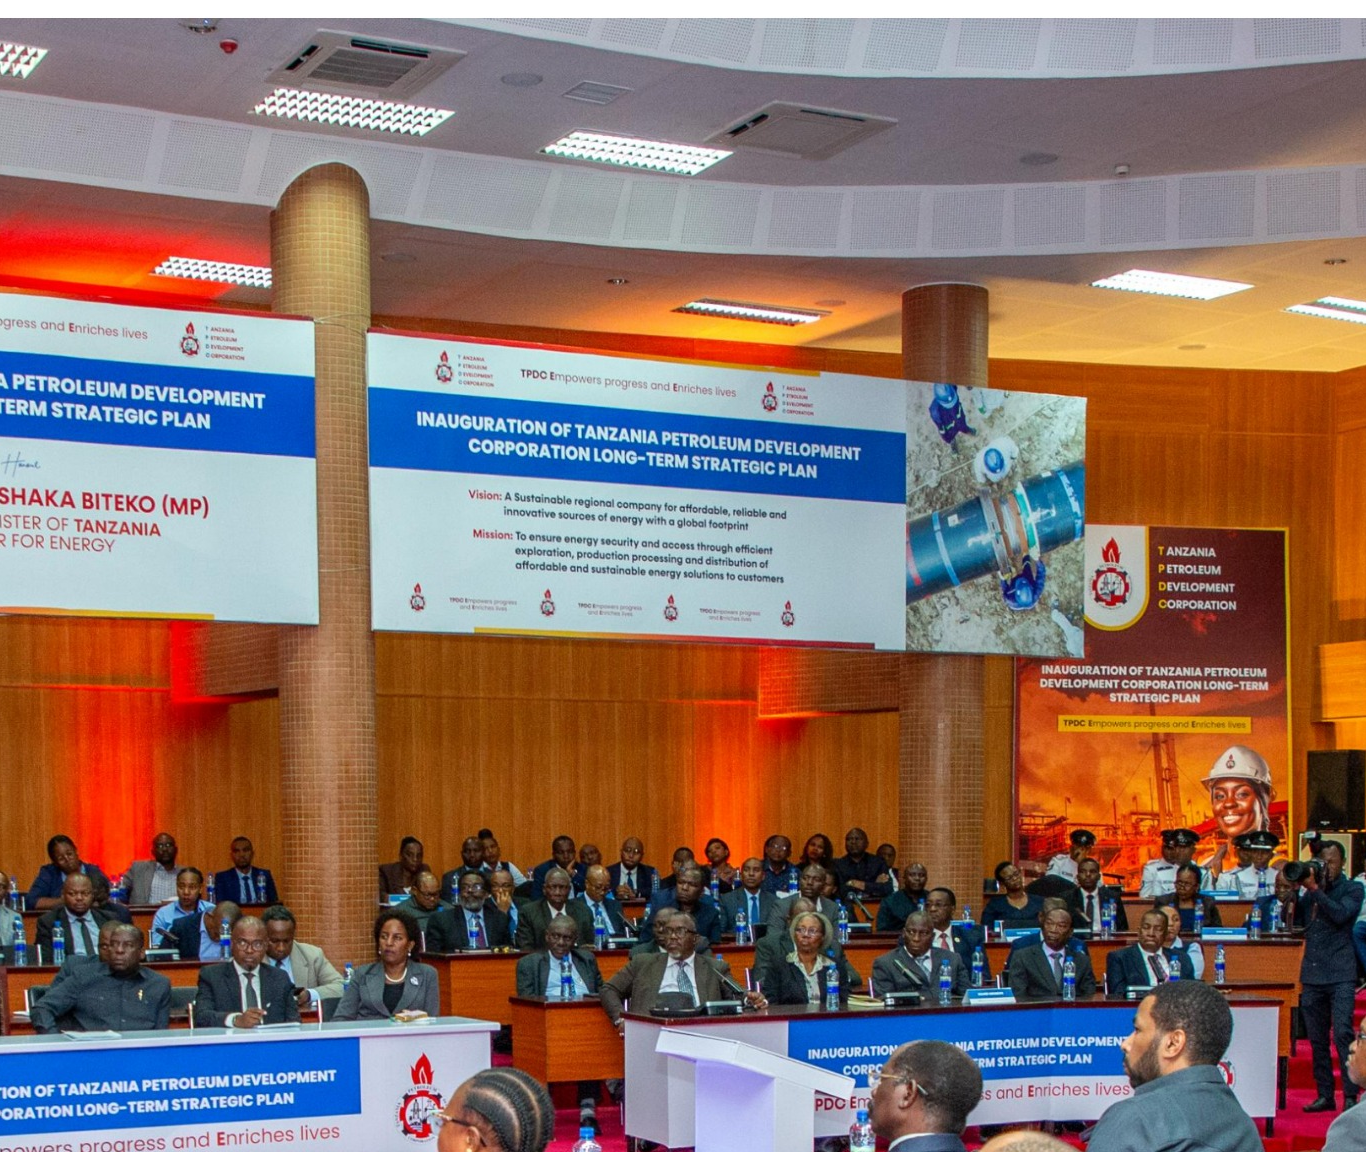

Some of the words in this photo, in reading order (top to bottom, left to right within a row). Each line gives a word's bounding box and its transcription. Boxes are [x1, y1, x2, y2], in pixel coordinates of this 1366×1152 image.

[40, 321, 64, 331] and
[68, 322, 118, 336] Enriches
[122, 327, 147, 339] lives
[12, 374, 126, 398] PETROLEUM
[131, 384, 265, 408] DEVELOPMENT
[520, 368, 547, 379] TPDC
[549, 371, 601, 384] Empowers
[605, 378, 647, 390] progress
[650, 382, 669, 391] and
[673, 382, 713, 395] Enriches
[715, 386, 737, 397] lives
[51, 402, 157, 425] STRATEGIC
[162, 411, 210, 429] PLAN
[417, 411, 546, 435] INAUGURATION
[550, 422, 571, 437] OF
[574, 424, 658, 444] TANZANIA
[661, 431, 751, 451] PETROLEUM
[755, 439, 861, 460] DEVELOPMENT
[468, 438, 590, 461] CORPORATION
[593, 447, 688, 468] LONG-TERM
[691, 455, 775, 474] STRATEGIC
[779, 462, 816, 478] PLAN
[82, 492, 155, 513] BITEKO
[162, 494, 208, 518] (MP)
[468, 489, 501, 500] Vision:
[504, 492, 511, 501] A
[514, 492, 571, 504] Sustainable
[574, 497, 614, 508] regional
[616, 501, 661, 512] company
[664, 502, 677, 511] for
[679, 503, 730, 516] affordable,
[733, 507, 767, 518] reliable
[769, 510, 786, 519] and
[46, 516, 68, 530] OF
[73, 518, 161, 536] TANZANIA
[503, 506, 555, 518] innovative
[558, 512, 595, 520] sources
[597, 512, 607, 521] of
[609, 515, 643, 525] energy
[645, 515, 666, 525] with
[677, 517, 706, 528] global
[708, 519, 748, 531] footprint
[12, 533, 44, 548] FOR
[50, 535, 115, 552] ENERGY
[473, 529, 512, 539] Mission:
[515, 531, 526, 540] To
[529, 534, 561, 543] ensure
[564, 536, 598, 546] energy
[601, 537, 639, 549] security
[641, 539, 659, 548] and
[661, 542, 694, 550] access
[697, 541, 733, 553] through
[735, 544, 773, 554] efficient
[515, 547, 574, 560] exploration,
[577, 550, 629, 562] production
[631, 553, 682, 565] processing
[685, 556, 703, 564] and
[705, 556, 757, 567] distribution
[759, 559, 768, 568] of
[515, 560, 567, 571] affordable
[569, 564, 588, 572] and
[591, 565, 645, 575] sustainable
[648, 569, 681, 579] energy
[683, 569, 724, 580] solutions
[726, 572, 735, 580] to
[737, 573, 784, 583] customers
[1041, 665, 1127, 675] INAUGURATION
[1129, 666, 1144, 675] OF
[1146, 666, 1202, 676] TANZANIA
[1204, 667, 1267, 677] PETROLEUM
[1040, 678, 1119, 689] DEVELOPMENT
[1121, 679, 1201, 689] CORPORATION
[1203, 680, 1268, 690] LONG-TERM
[1109, 692, 1171, 703] STRATEGIC
[1172, 693, 1200, 703] PLAN
[1063, 719, 1086, 727] TPDC
[1088, 719, 1131, 729] Empowers
[1133, 720, 1170, 730] progress
[1173, 720, 1189, 728] and
[1191, 720, 1225, 728] Enriches
[1227, 720, 1246, 728] lives
[808, 1044, 897, 1060] INAUGURATION
[977, 1038, 1039, 1050] PETROLEUM
[997, 1054, 1056, 1067] STRATEGIC
[1059, 1053, 1092, 1065] PLAN
[34, 1084, 55, 1097] OF
[57, 1080, 139, 1095] TANZANIA
[142, 1075, 229, 1091] PETROLEUM
[232, 1069, 336, 1086] DEVELOPMENT
[76, 1099, 168, 1116] LONG-TERM
[171, 1094, 253, 1110] STRATEGIC
[256, 1092, 293, 1105] PLAN
[815, 1098, 845, 1111] PDC
[996, 1085, 1023, 1100] and
[1028, 1082, 1090, 1098] Enriches
[1096, 1082, 1130, 1095] lives
[172, 1131, 209, 1148] and
[217, 1128, 293, 1146] Enriches
[301, 1125, 339, 1140] lives
